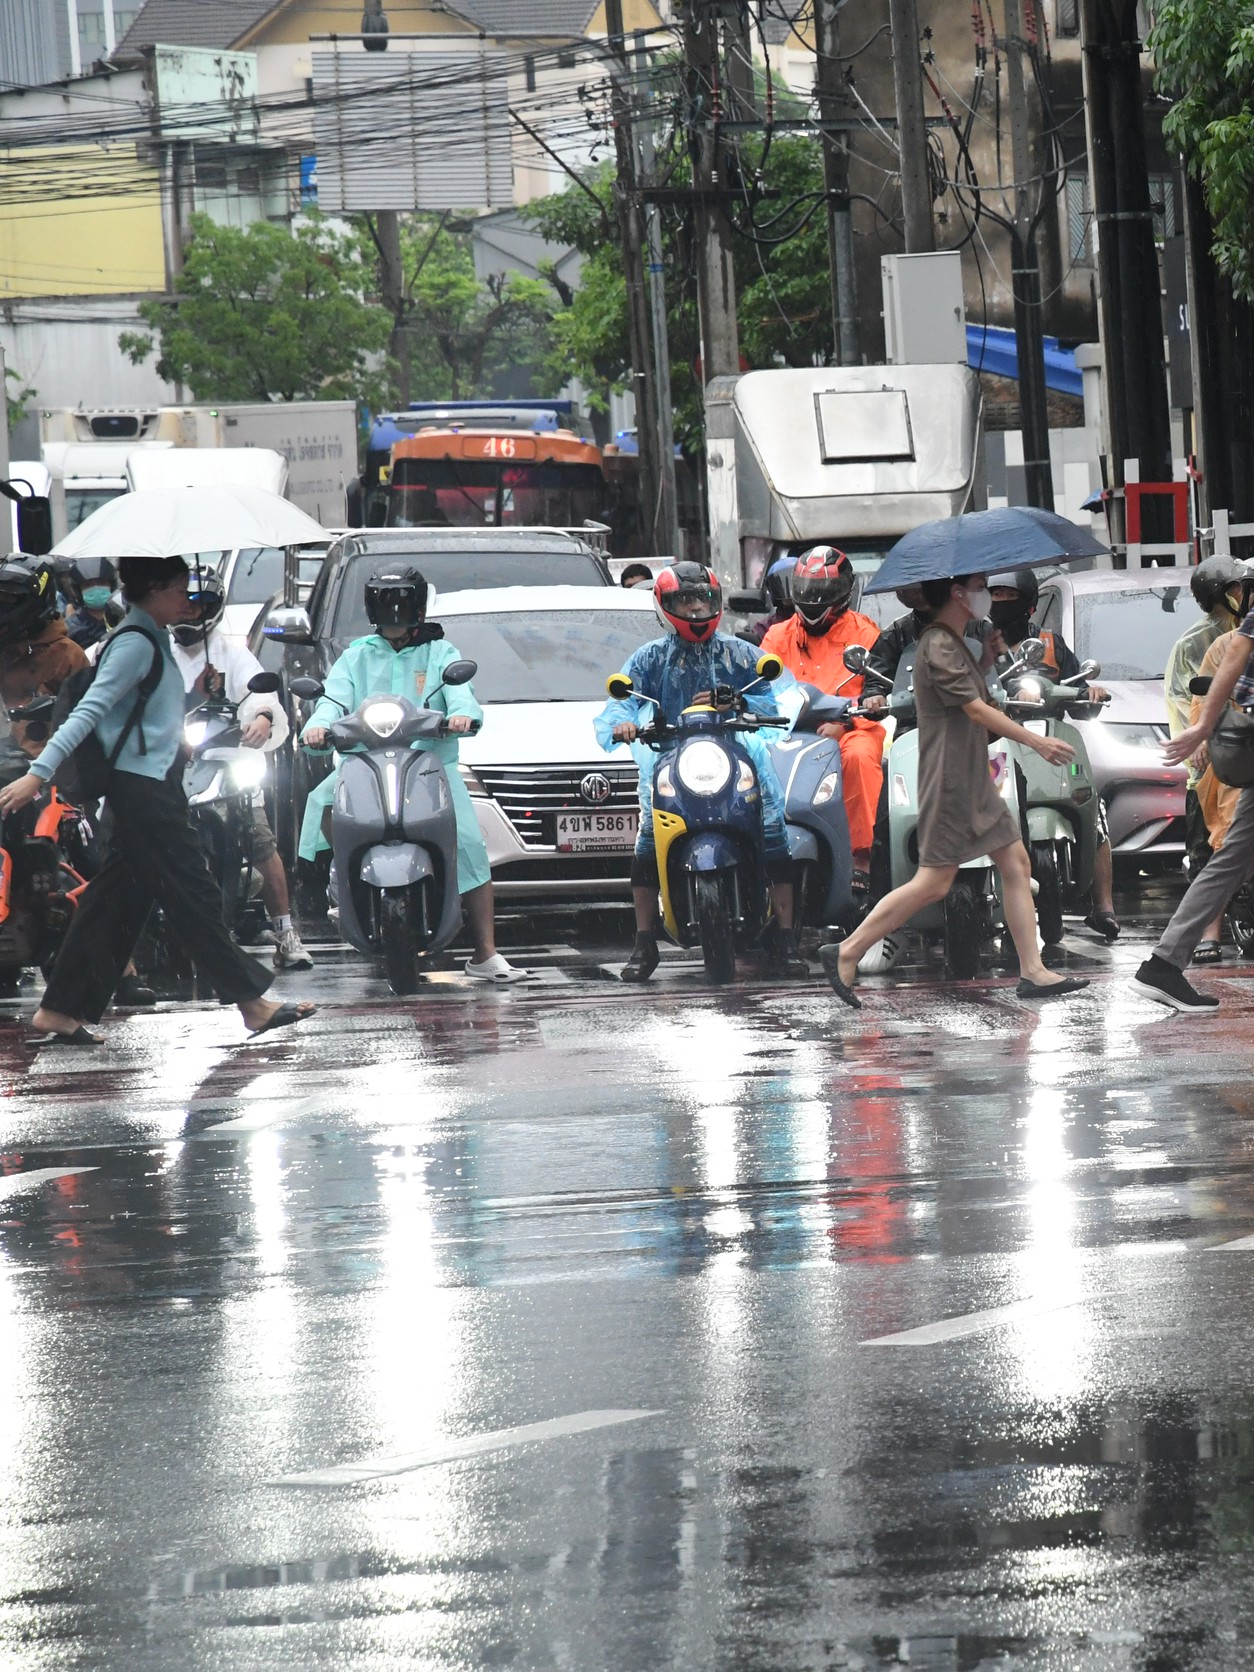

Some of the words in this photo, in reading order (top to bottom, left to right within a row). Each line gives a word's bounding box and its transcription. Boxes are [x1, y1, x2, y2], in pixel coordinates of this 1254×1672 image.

[482, 437, 516, 457] 46
[584, 776, 607, 799] MG
[596, 815, 633, 832] 5861
